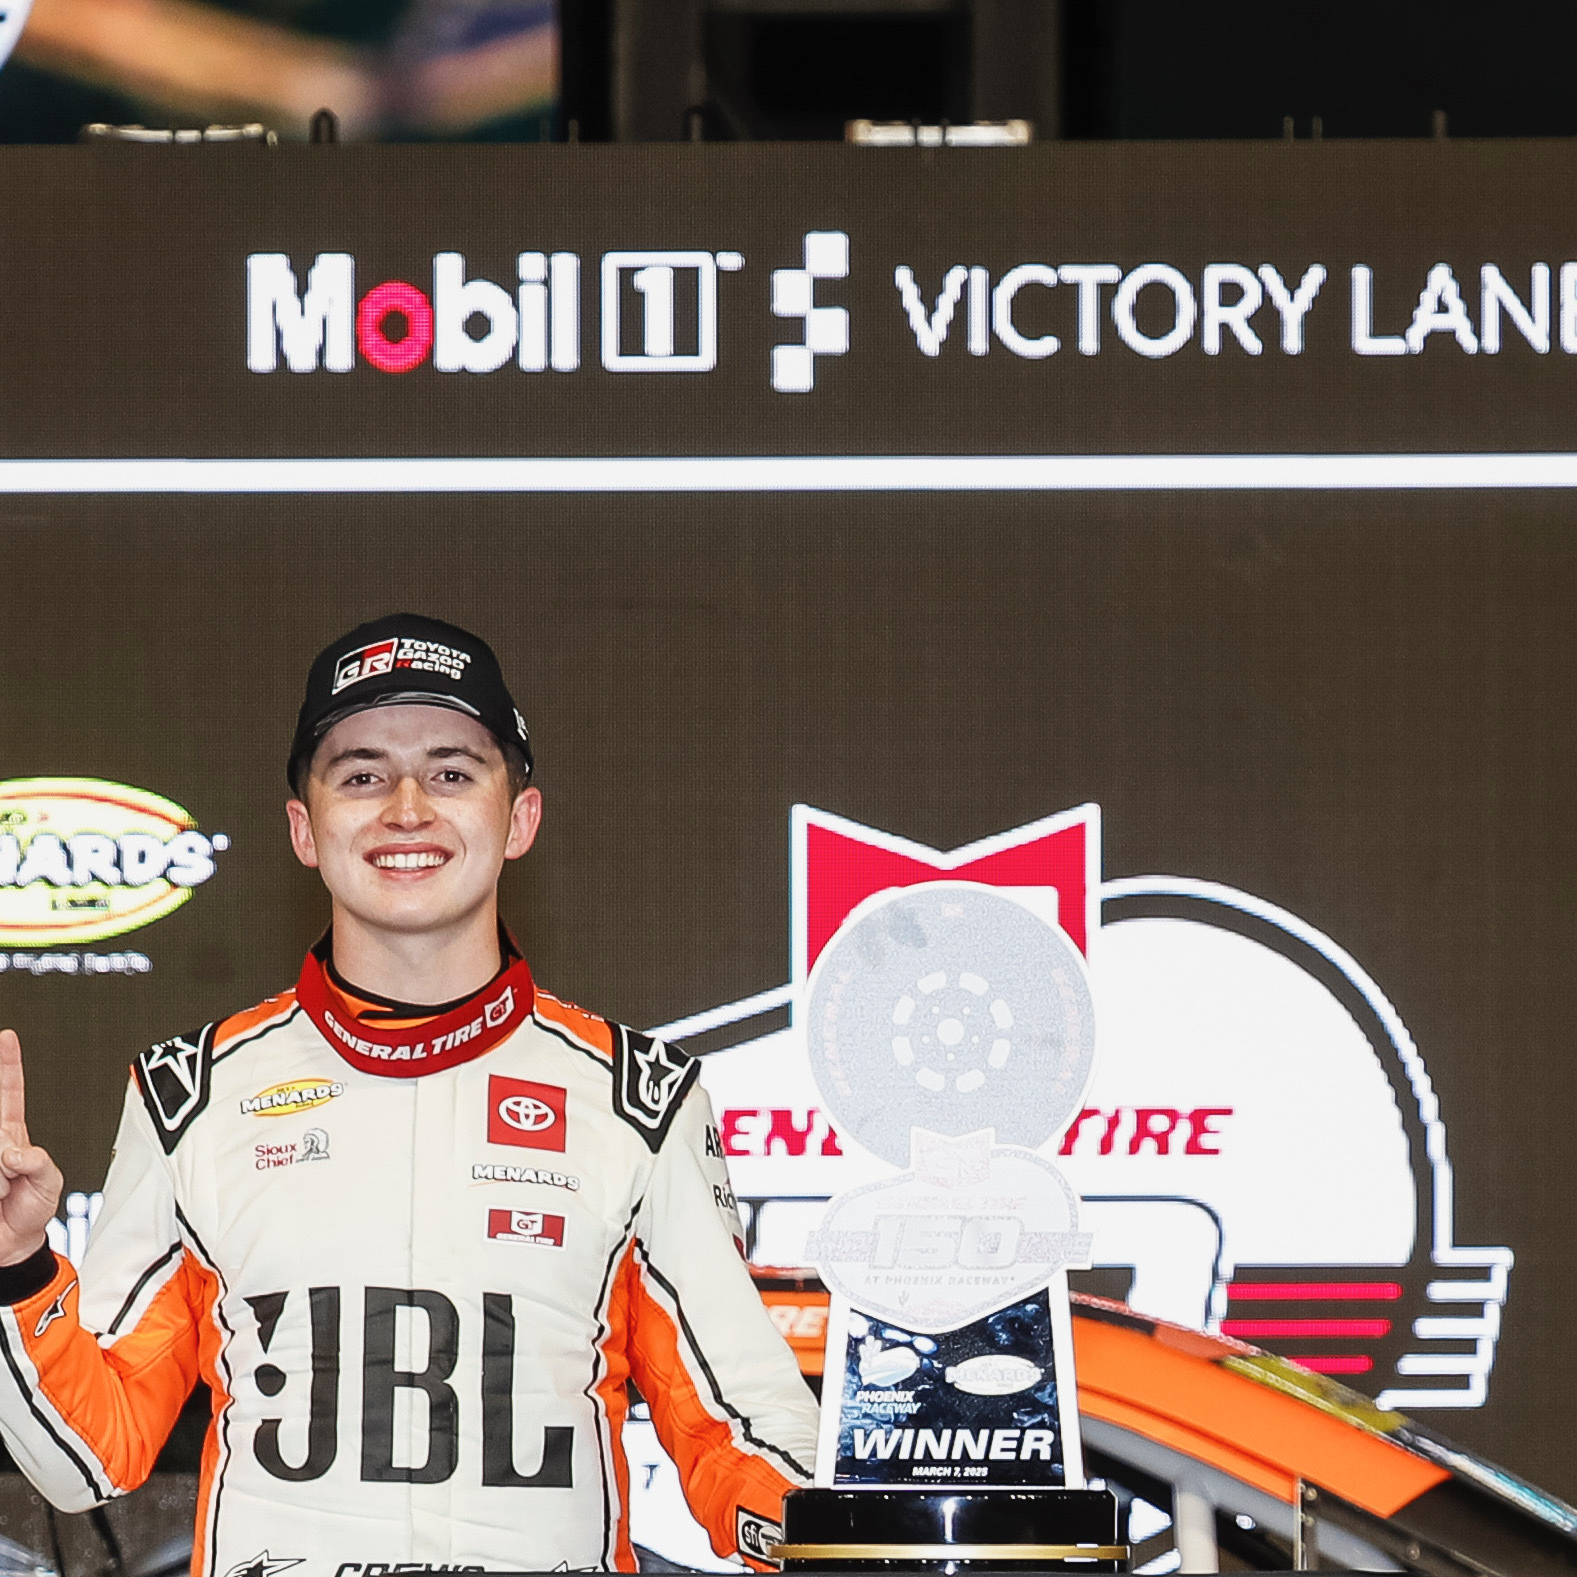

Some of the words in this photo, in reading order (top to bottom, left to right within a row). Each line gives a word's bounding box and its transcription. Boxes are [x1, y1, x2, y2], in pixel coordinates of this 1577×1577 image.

[246, 250, 581, 374] Mobil
[895, 262, 1327, 359] VICTORY
[397, 649, 465, 671] GAZOO
[400, 638, 472, 664] TOYOTA
[336, 652, 391, 690] GR
[395, 660, 462, 680] Racing
[324, 1010, 427, 1061] GENERAL
[431, 1016, 484, 1056] TIRE
[240, 1082, 344, 1115] MENARDS
[255, 1143, 298, 1158] Sioux
[255, 1153, 294, 1171] Chief
[471, 1164, 580, 1192] MENARDS
[516, 1218, 538, 1230] GT
[869, 1215, 1023, 1270] 150
[243, 1285, 574, 1490] JBL
[856, 1389, 917, 1404] PHOENIX
[861, 1401, 922, 1415] RACEWAY
[853, 1427, 1055, 1462] WINNER
[912, 1466, 952, 1478] MARCH
